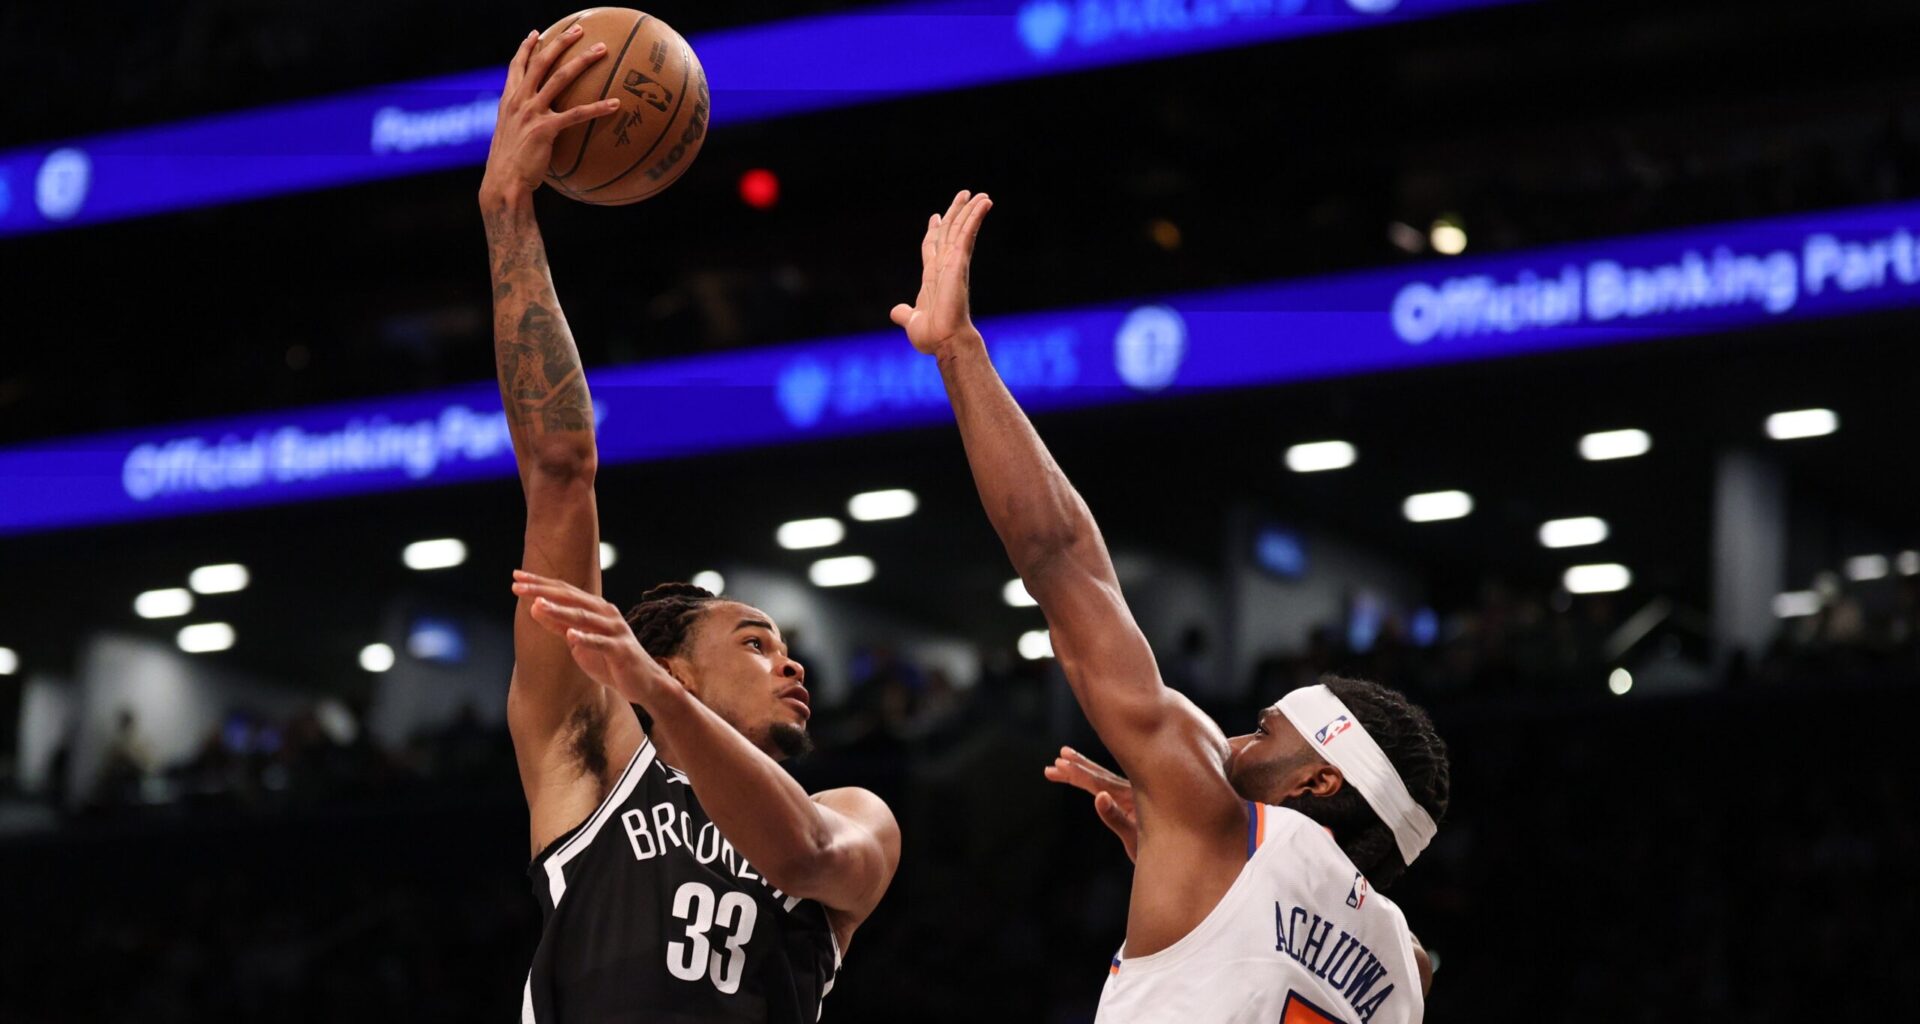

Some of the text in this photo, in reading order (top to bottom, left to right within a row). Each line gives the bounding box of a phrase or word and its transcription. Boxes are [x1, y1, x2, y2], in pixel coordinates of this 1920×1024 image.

[371, 97, 500, 154] Powerin
[1393, 226, 1920, 343] Official Banking Part
[124, 432, 265, 500] Official
[271, 414, 437, 478] Banking
[666, 881, 758, 995] 33
[1275, 900, 1395, 1024] ACHIUWA
